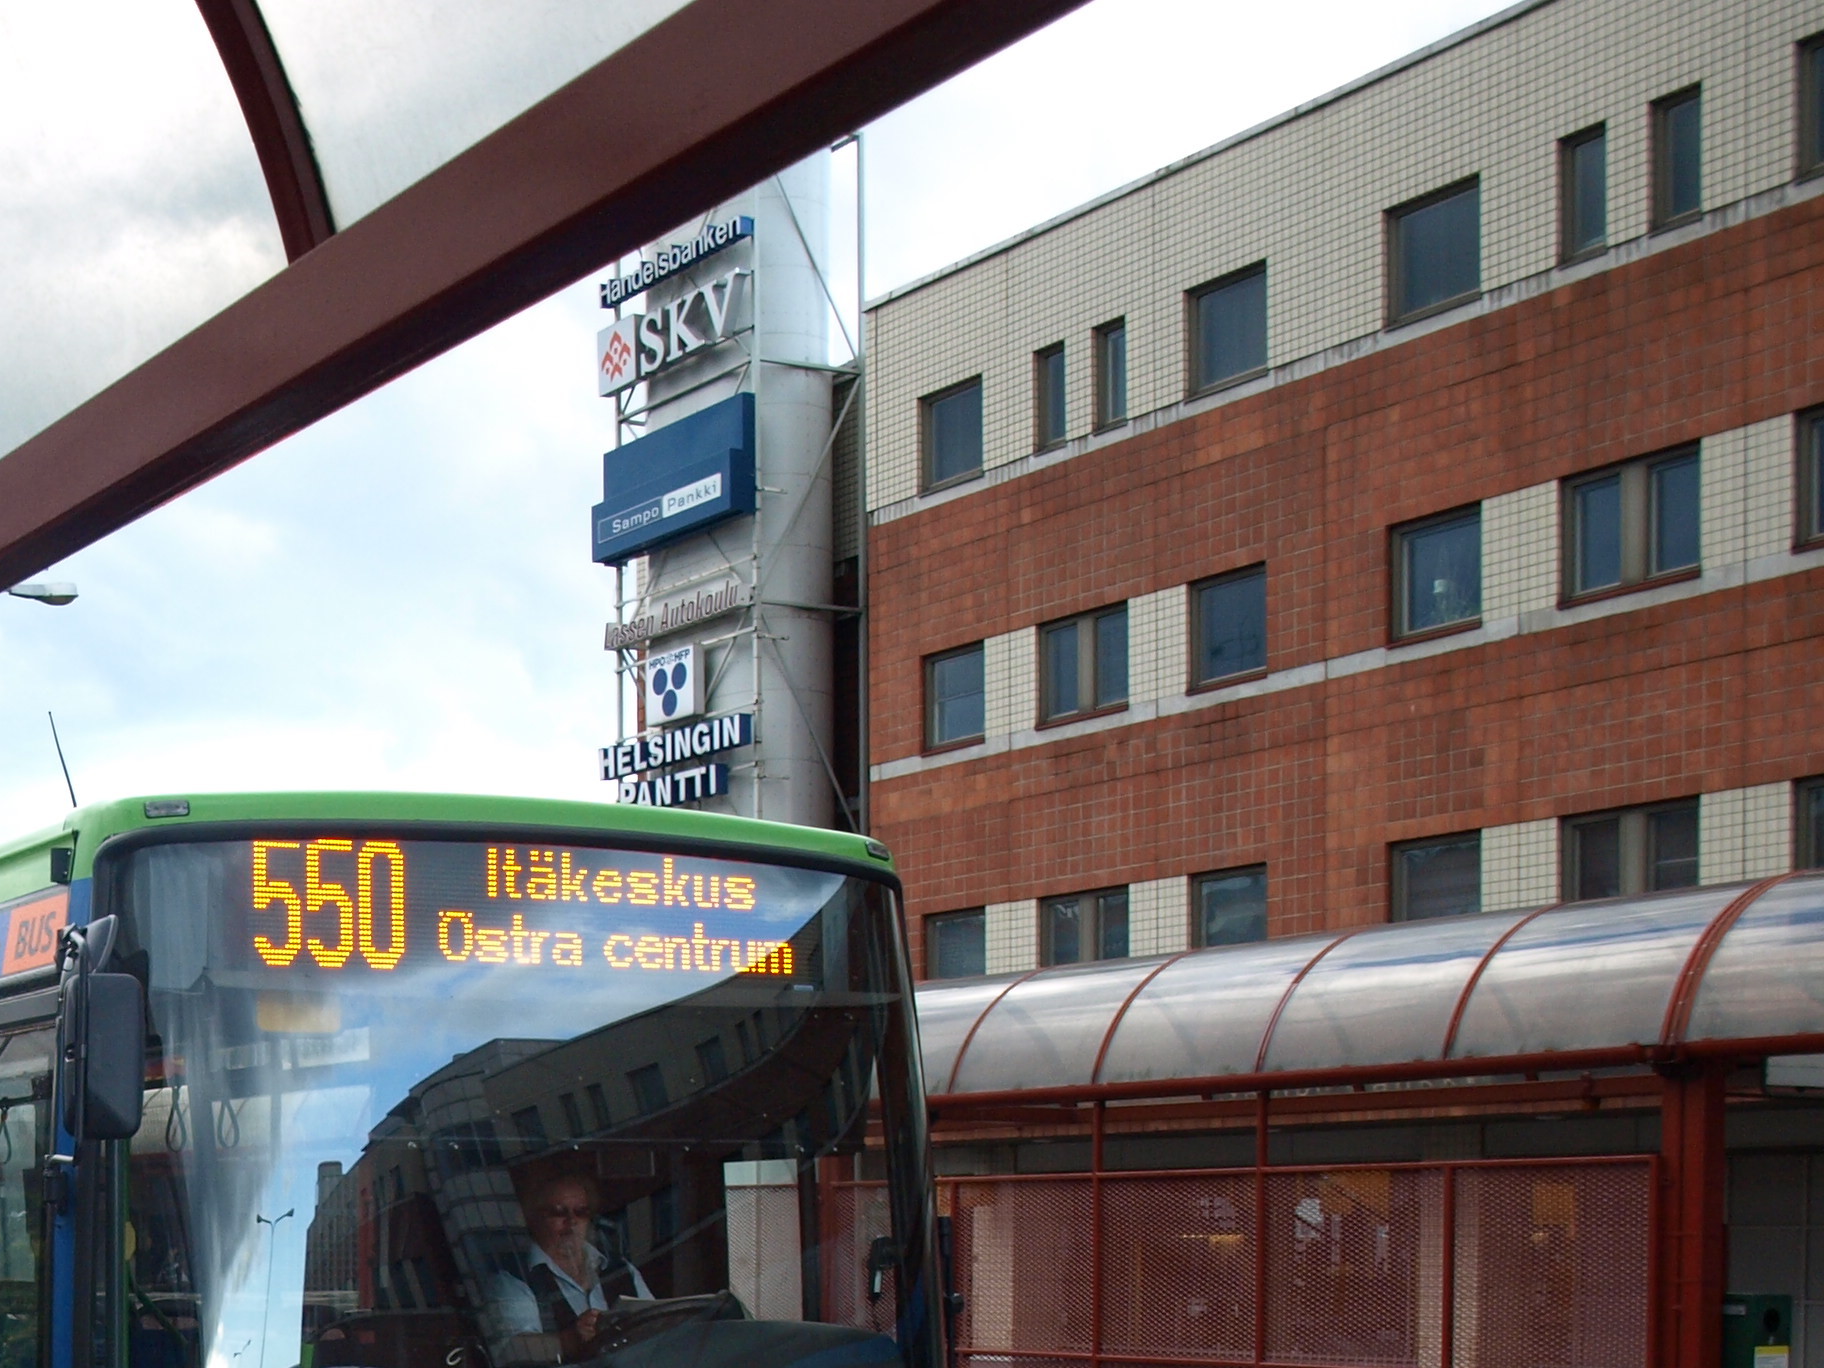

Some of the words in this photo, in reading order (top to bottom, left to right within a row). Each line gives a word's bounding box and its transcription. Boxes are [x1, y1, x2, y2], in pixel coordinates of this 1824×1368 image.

[601, 215, 741, 305] Handelsbanken
[639, 267, 753, 376] SKV
[612, 507, 660, 534] Sampo
[666, 480, 718, 512] Pankki
[660, 580, 739, 632] Autokoulu
[599, 714, 741, 781] HELSINGIN
[619, 765, 717, 807] PANTTI
[253, 839, 405, 969] 550
[487, 847, 755, 911] Itäkeskus
[14, 911, 56, 959] BUS
[604, 922, 793, 976] centrum
